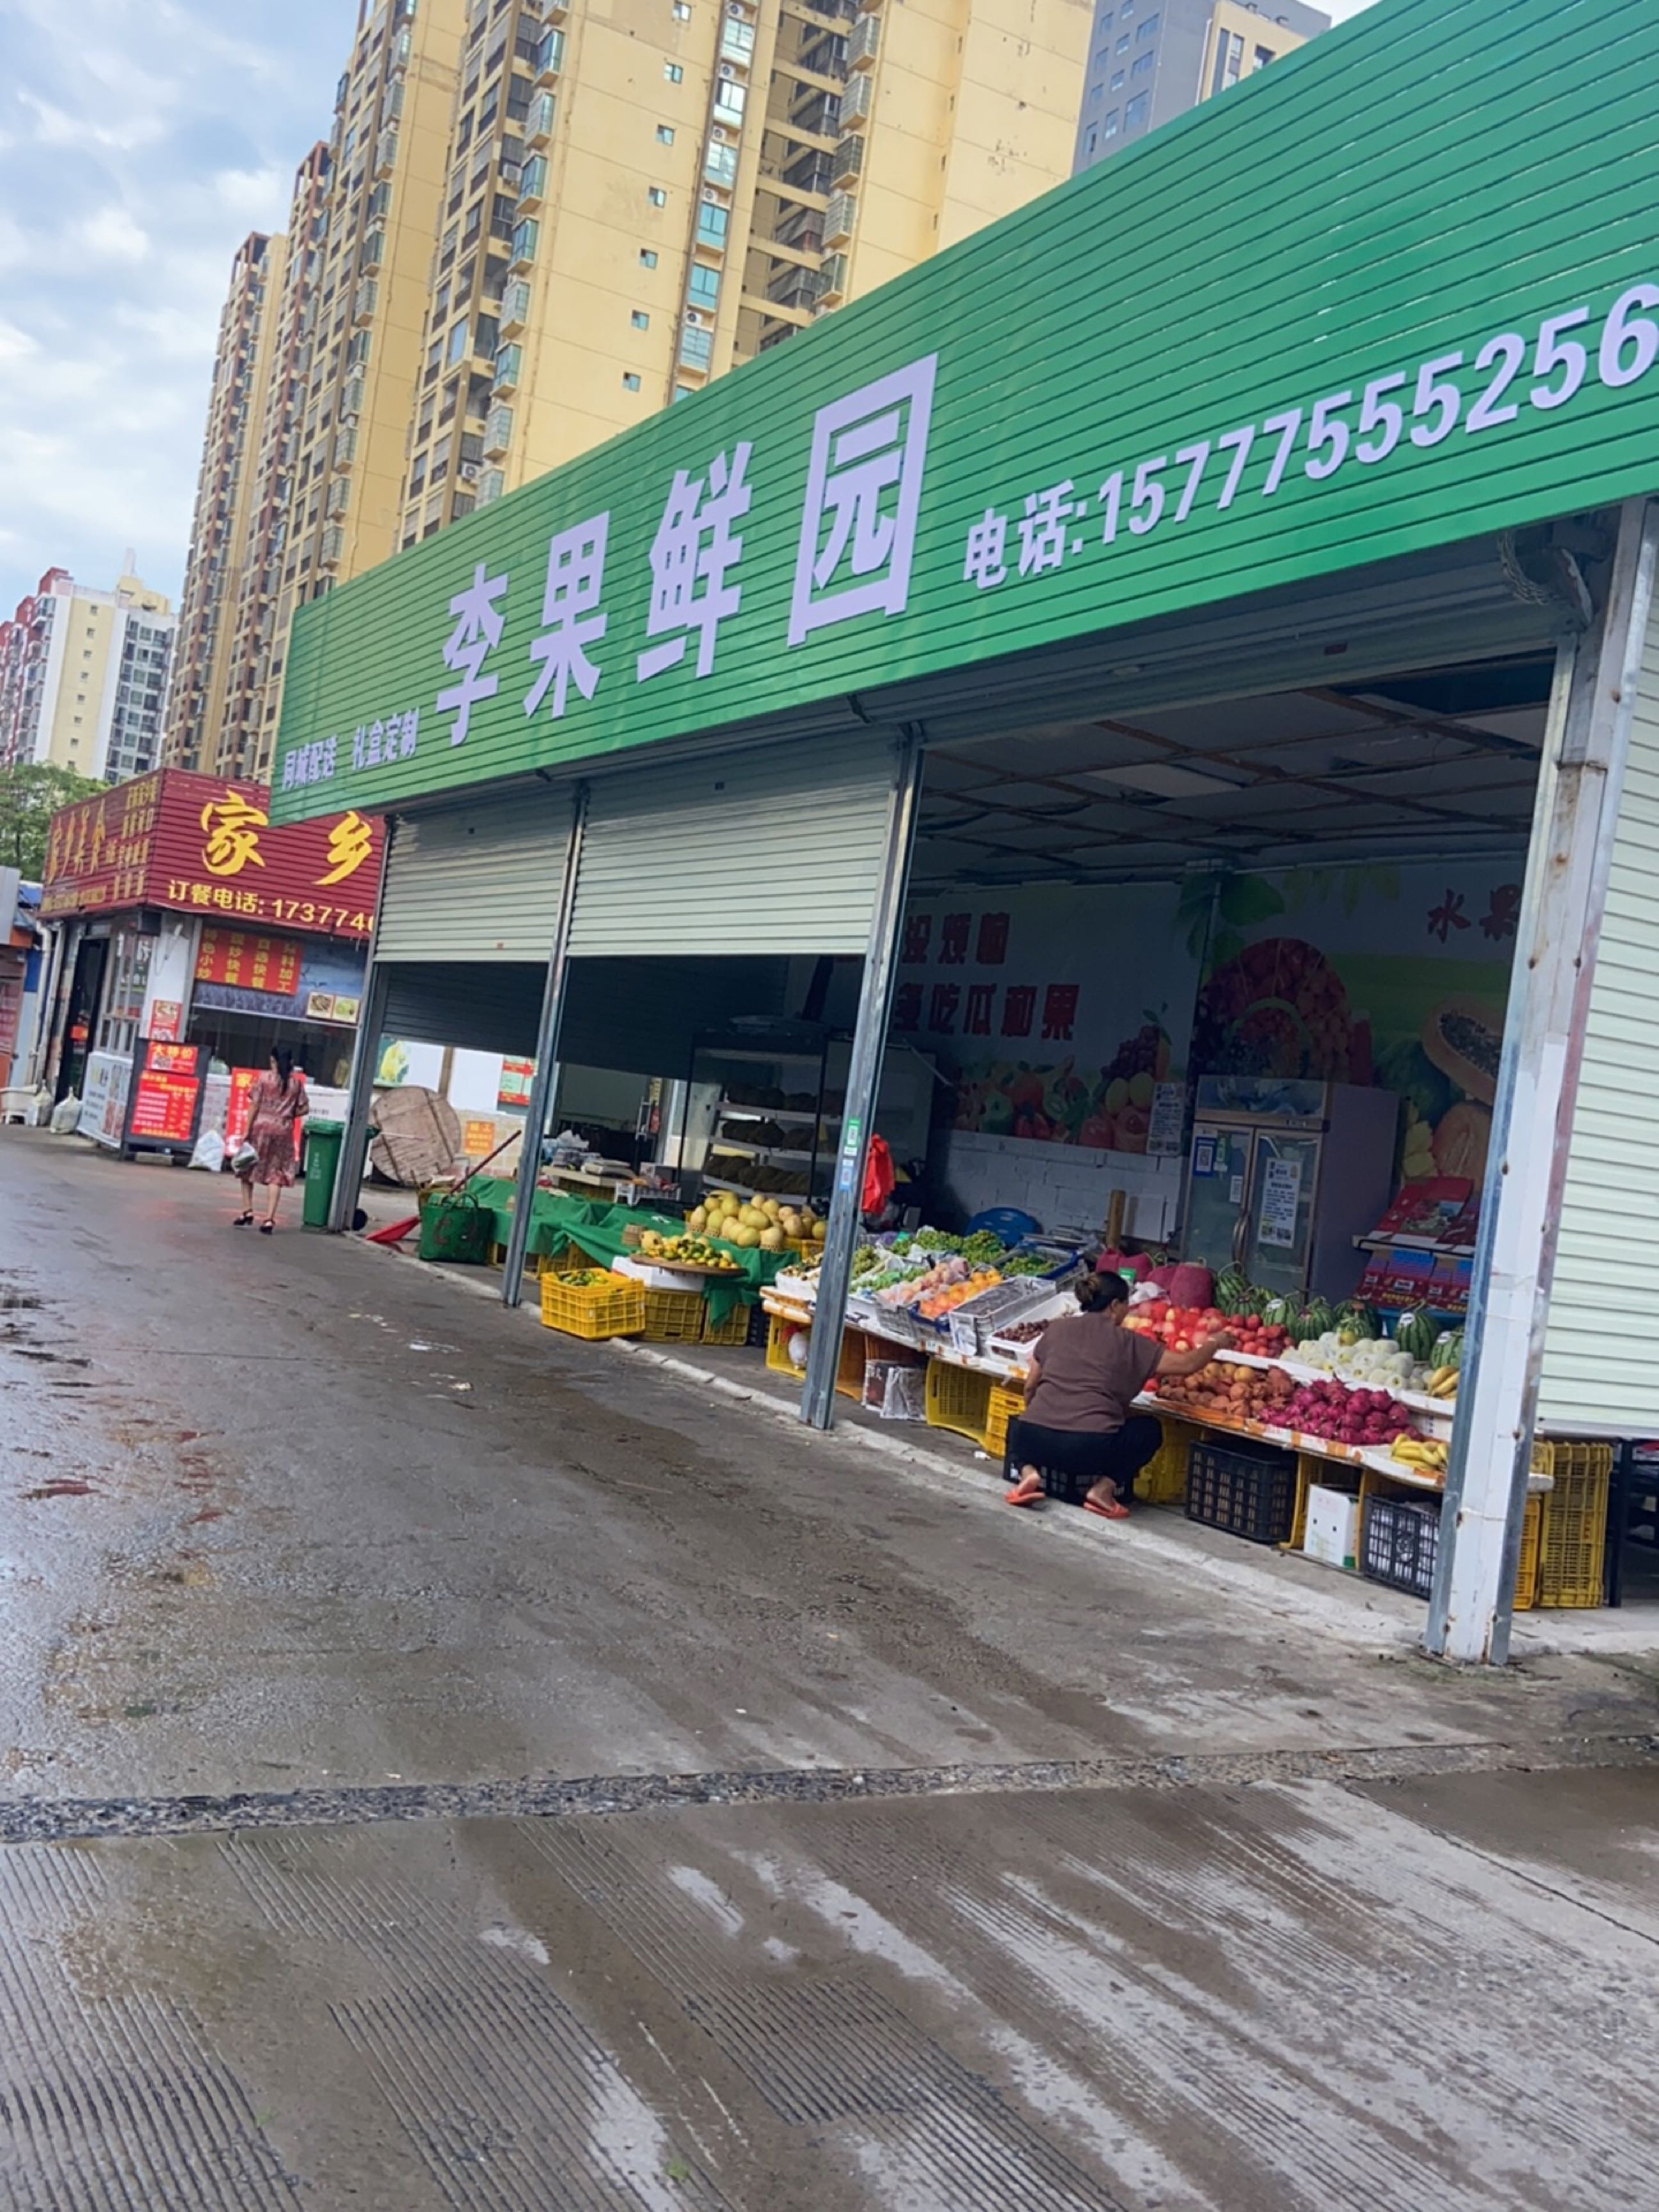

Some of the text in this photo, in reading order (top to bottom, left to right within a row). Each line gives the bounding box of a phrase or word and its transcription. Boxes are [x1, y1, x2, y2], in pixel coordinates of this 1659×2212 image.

[435, 353, 939, 748] 李果鲜园
[282, 706, 420, 792] 同城配送 礼盒定制
[200, 790, 373, 885] 家乡
